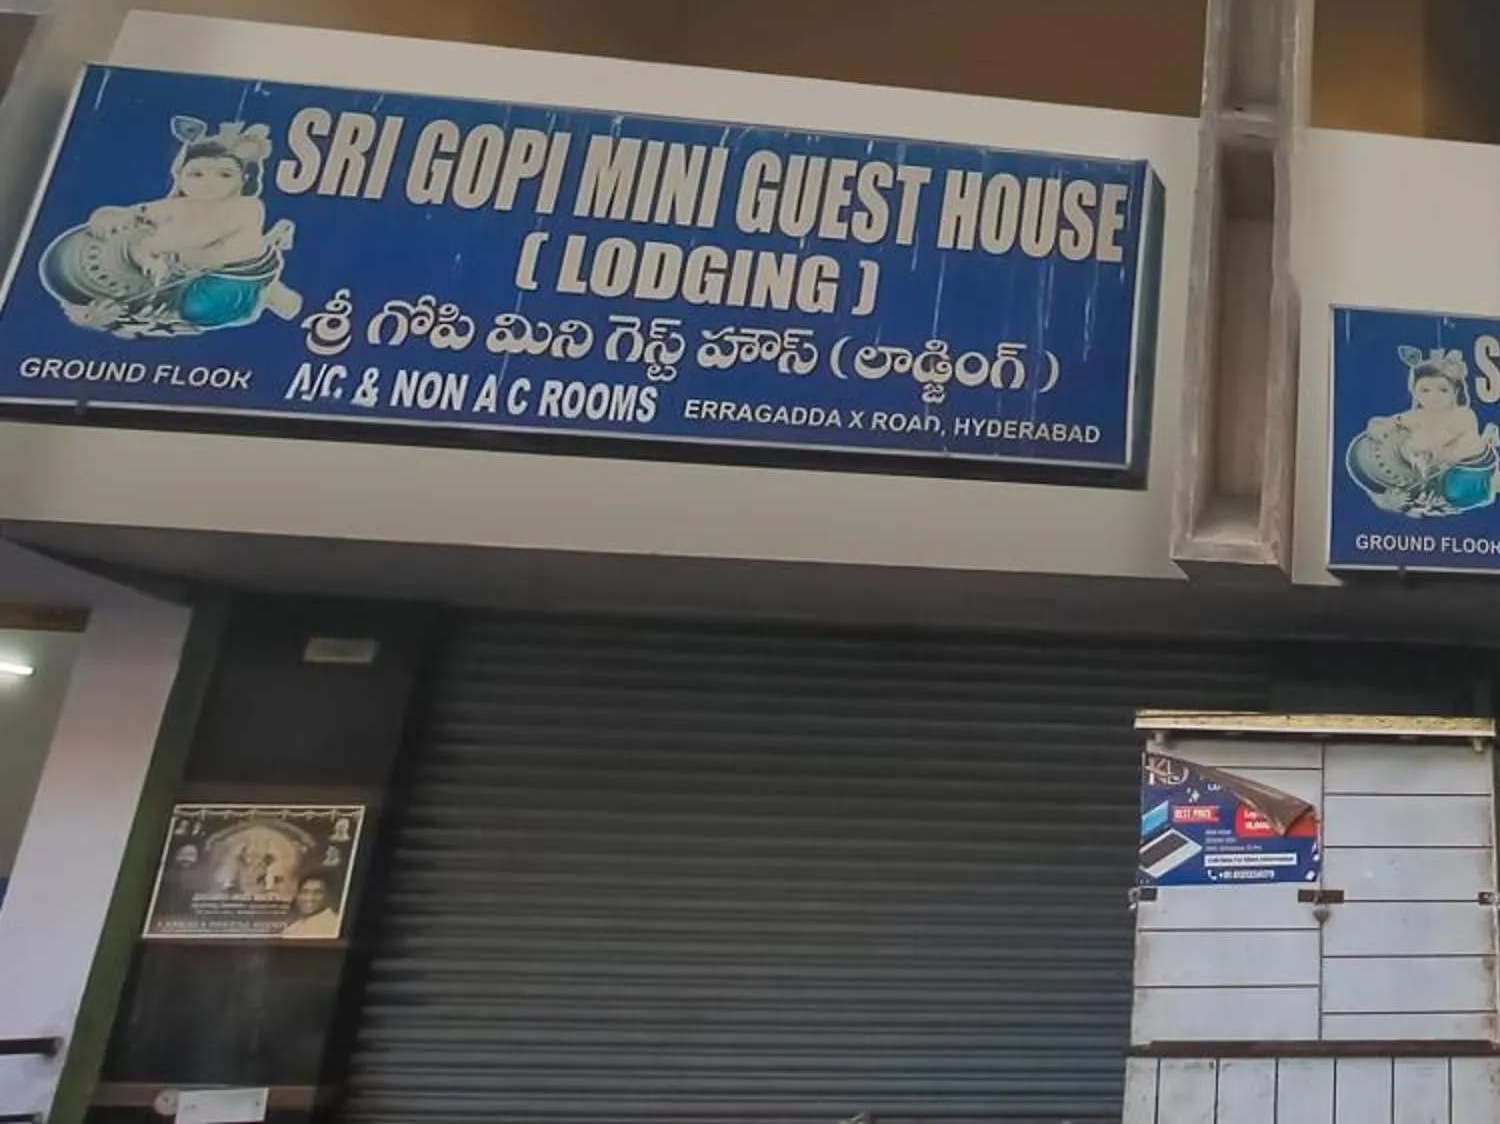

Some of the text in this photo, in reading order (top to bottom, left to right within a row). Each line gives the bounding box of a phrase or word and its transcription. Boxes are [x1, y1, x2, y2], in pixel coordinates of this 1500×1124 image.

[276, 107, 1129, 263] SRI GOPI MINI GUEST HOUSE
[302, 288, 352, 356] శ్రీ
[367, 294, 476, 351] గోపి
[486, 313, 593, 359] మిని
[604, 314, 687, 381] గెస్ట్
[19, 357, 146, 383] GROUND
[351, 367, 380, 408] &
[389, 369, 470, 411] NON
[538, 379, 658, 423] ROOMS
[683, 399, 1101, 445] ERRAGADDA X ROAD, HYDERABAD
[1355, 534, 1436, 552] GROUND
